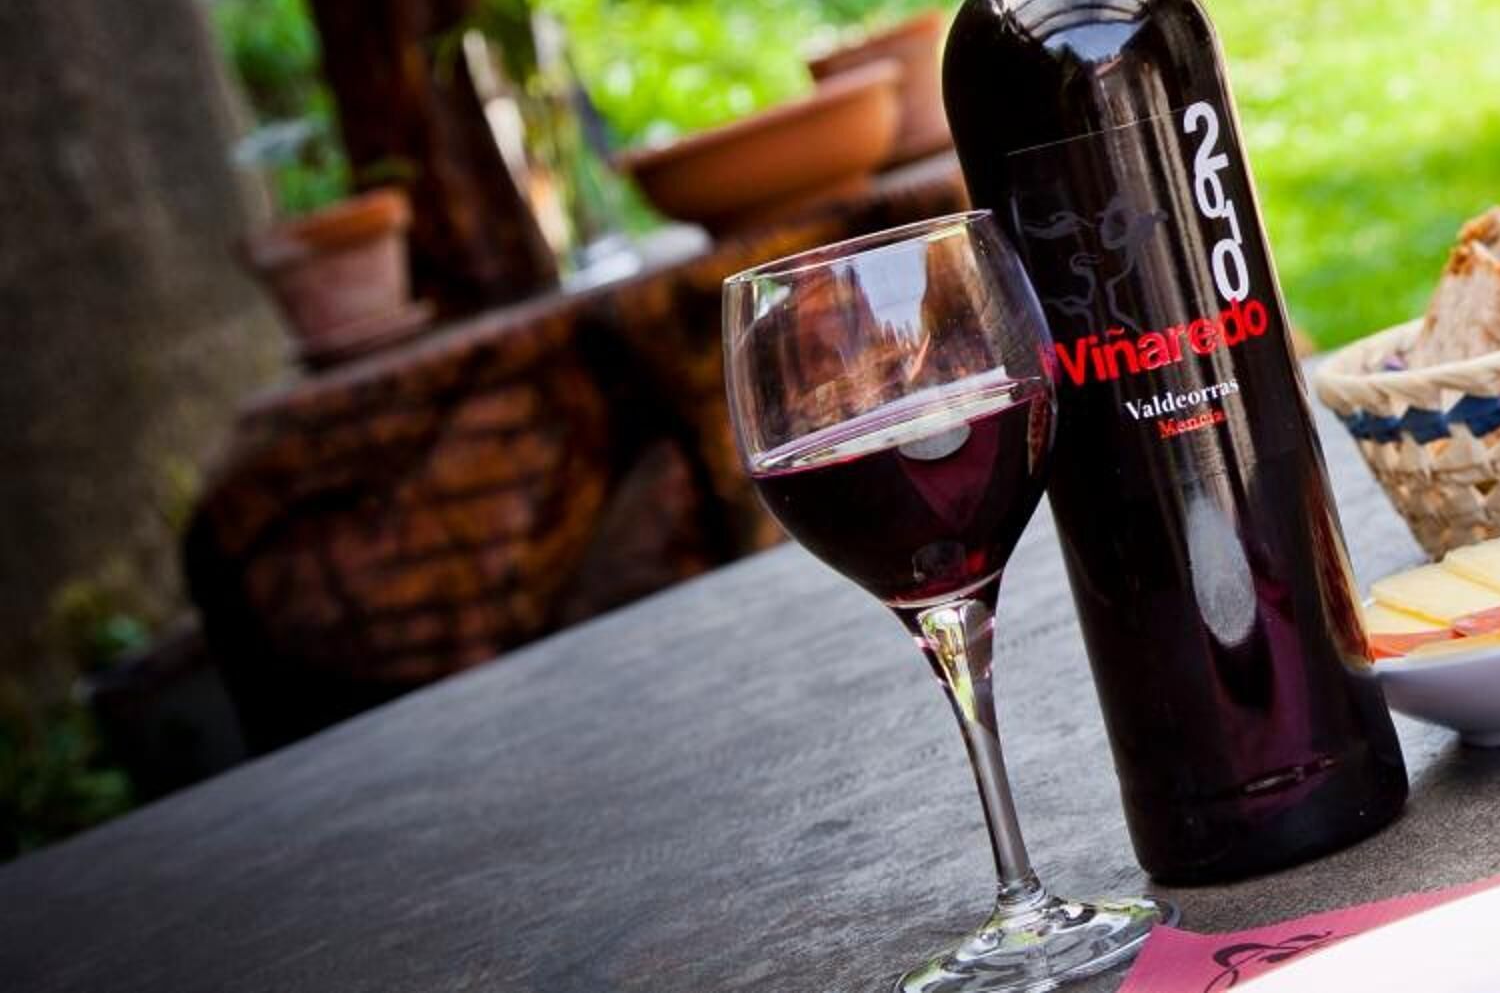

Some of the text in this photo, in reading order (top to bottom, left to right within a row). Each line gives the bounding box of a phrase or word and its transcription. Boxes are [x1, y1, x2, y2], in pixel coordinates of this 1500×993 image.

[1182, 101, 1251, 304] 2010
[1054, 298, 1269, 387] Viñaredo
[1125, 377, 1240, 421] Valdeorras
